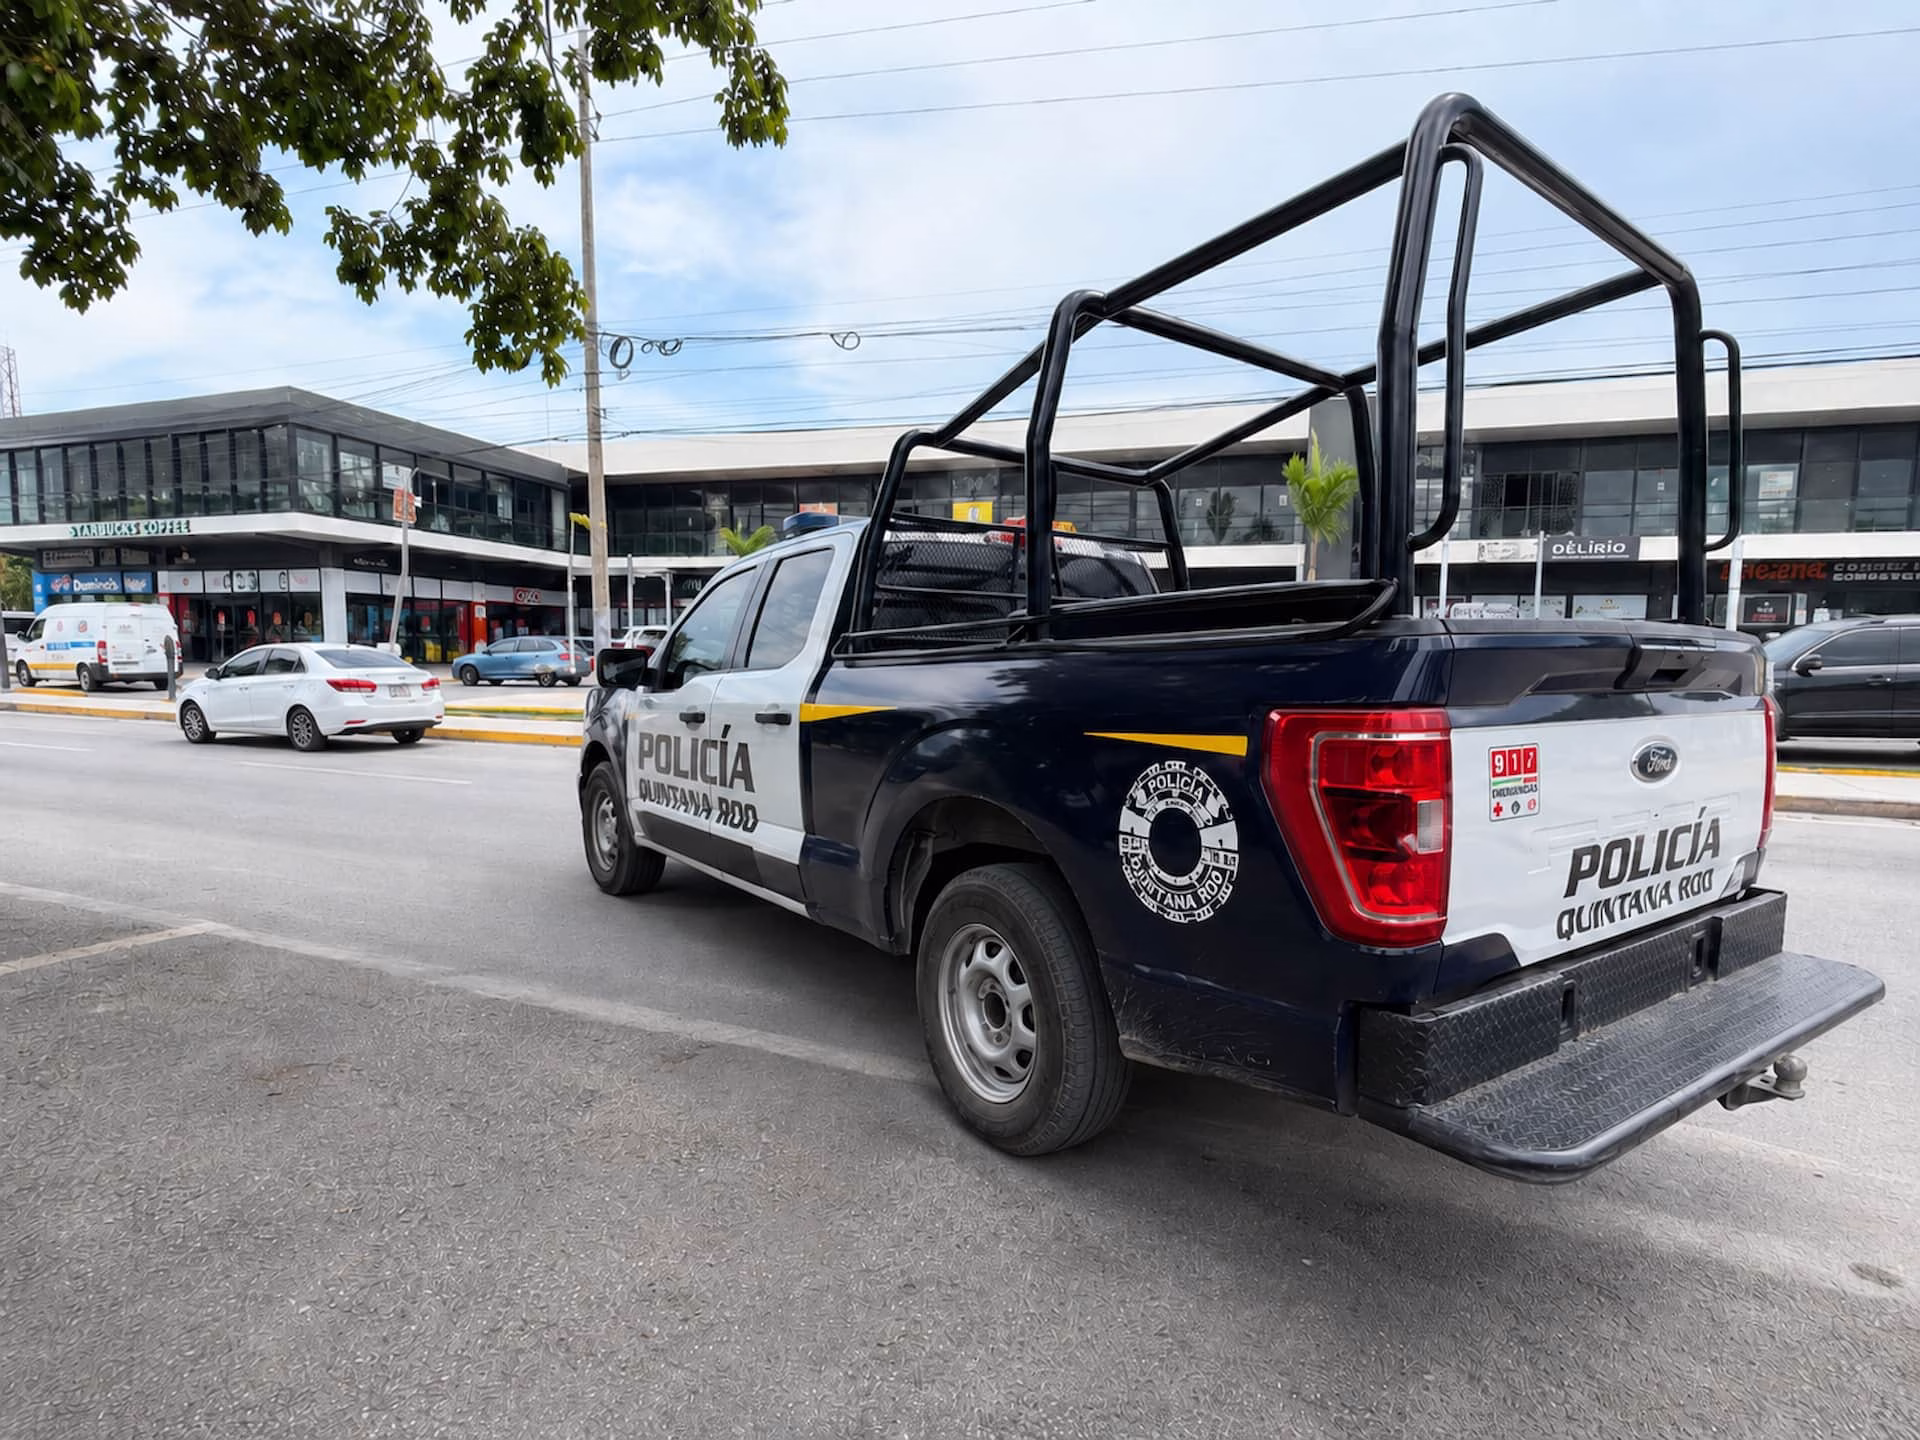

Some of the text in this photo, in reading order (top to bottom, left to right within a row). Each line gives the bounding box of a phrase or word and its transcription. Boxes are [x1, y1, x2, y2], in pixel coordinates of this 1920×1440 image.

[68, 519, 191, 537] STARBUCKS COFFEE
[638, 724, 756, 793] POLICÍA
[1647, 748, 1672, 773] Ford
[638, 777, 759, 833] QUINTANA ROO
[1563, 806, 1720, 898] POLICÍA
[1197, 869, 1223, 904] ROO
[1556, 868, 1714, 941] QUINTANA ROO
